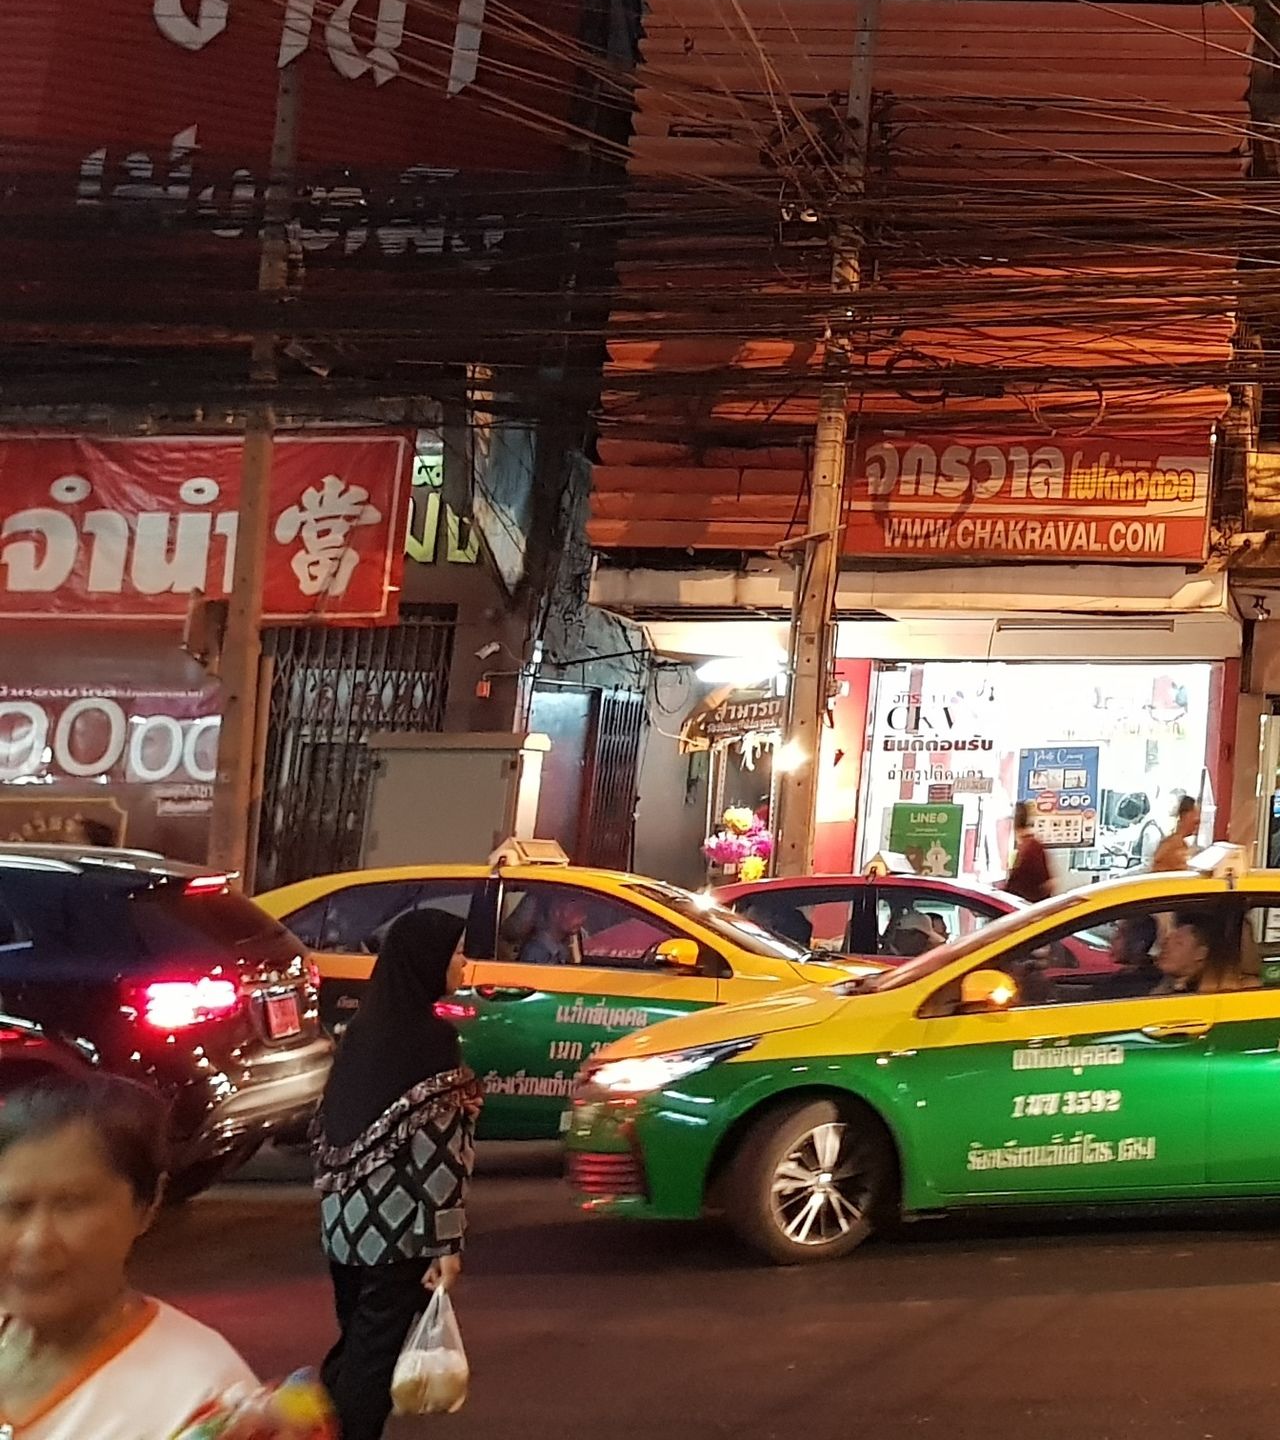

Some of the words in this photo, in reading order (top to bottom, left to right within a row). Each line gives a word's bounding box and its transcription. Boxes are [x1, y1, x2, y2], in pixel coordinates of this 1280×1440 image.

[275, 474, 382, 596] 當
[884, 519, 1166, 552] WWW.CHAKRAVAL.COM
[1062, 1089, 1122, 1116] 3592
